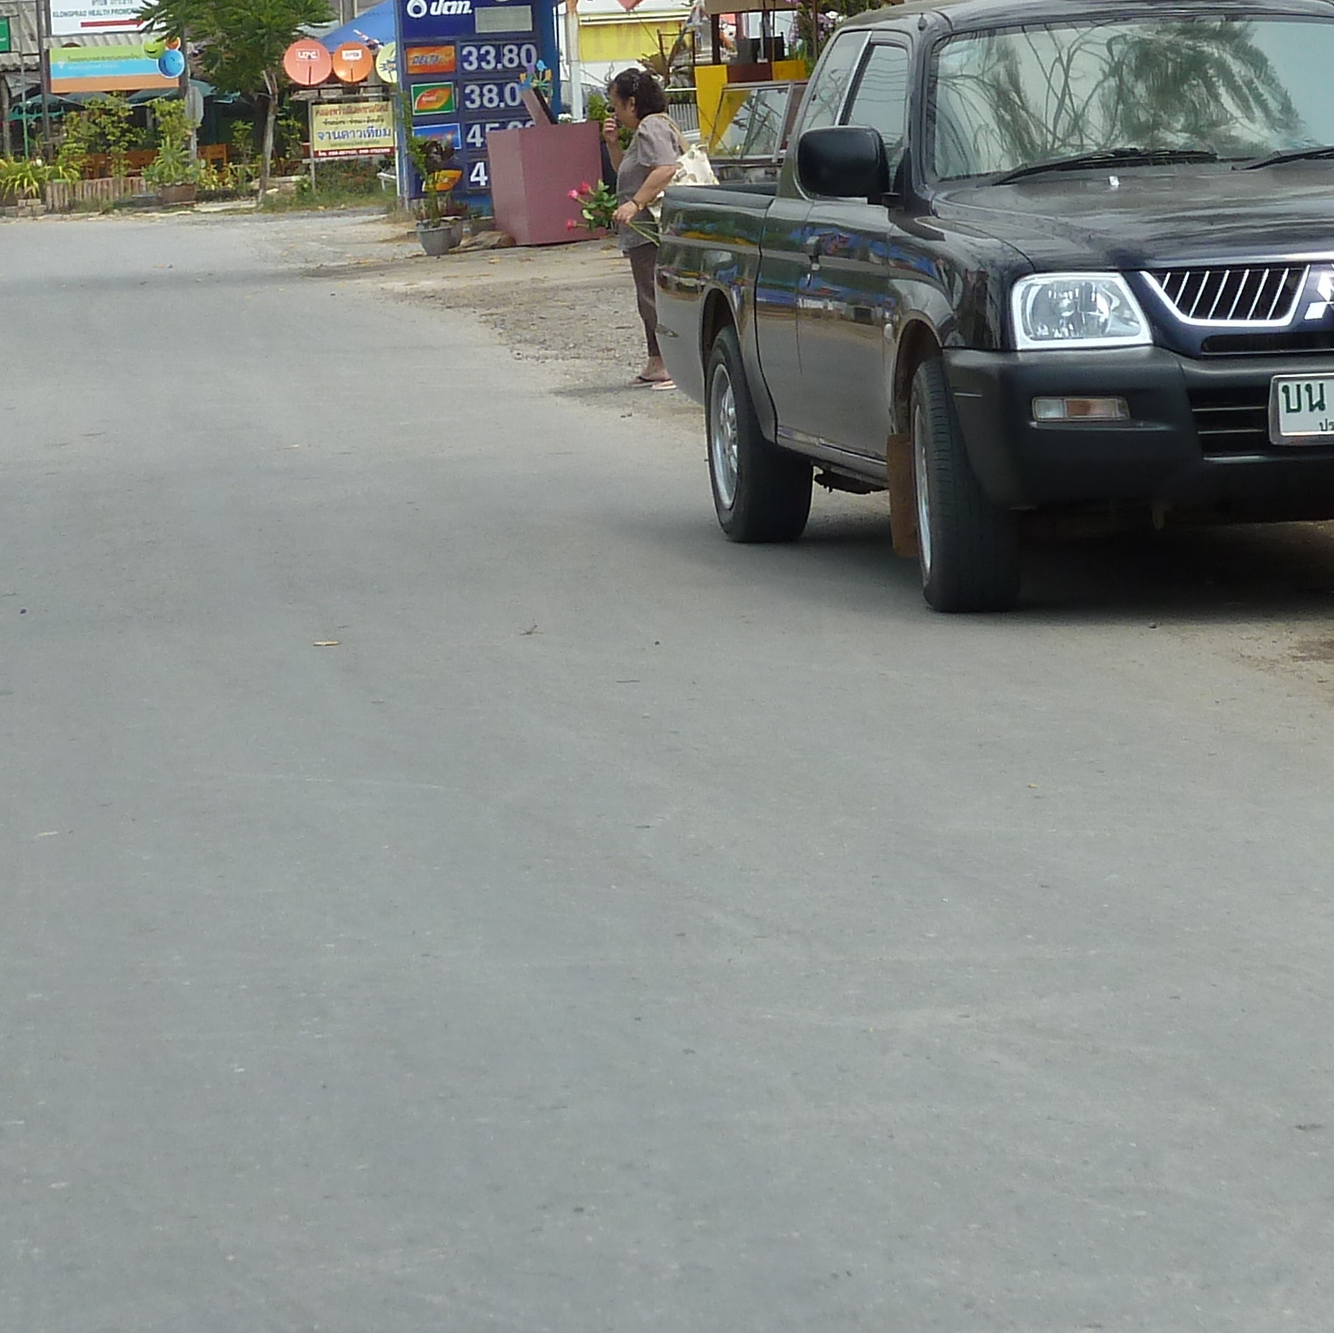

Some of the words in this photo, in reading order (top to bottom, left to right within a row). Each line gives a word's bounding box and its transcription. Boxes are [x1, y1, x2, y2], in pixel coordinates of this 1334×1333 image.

[462, 43, 538, 71] 33.80
[464, 82, 521, 109] 38.0
[1281, 381, 1327, 414] บน
